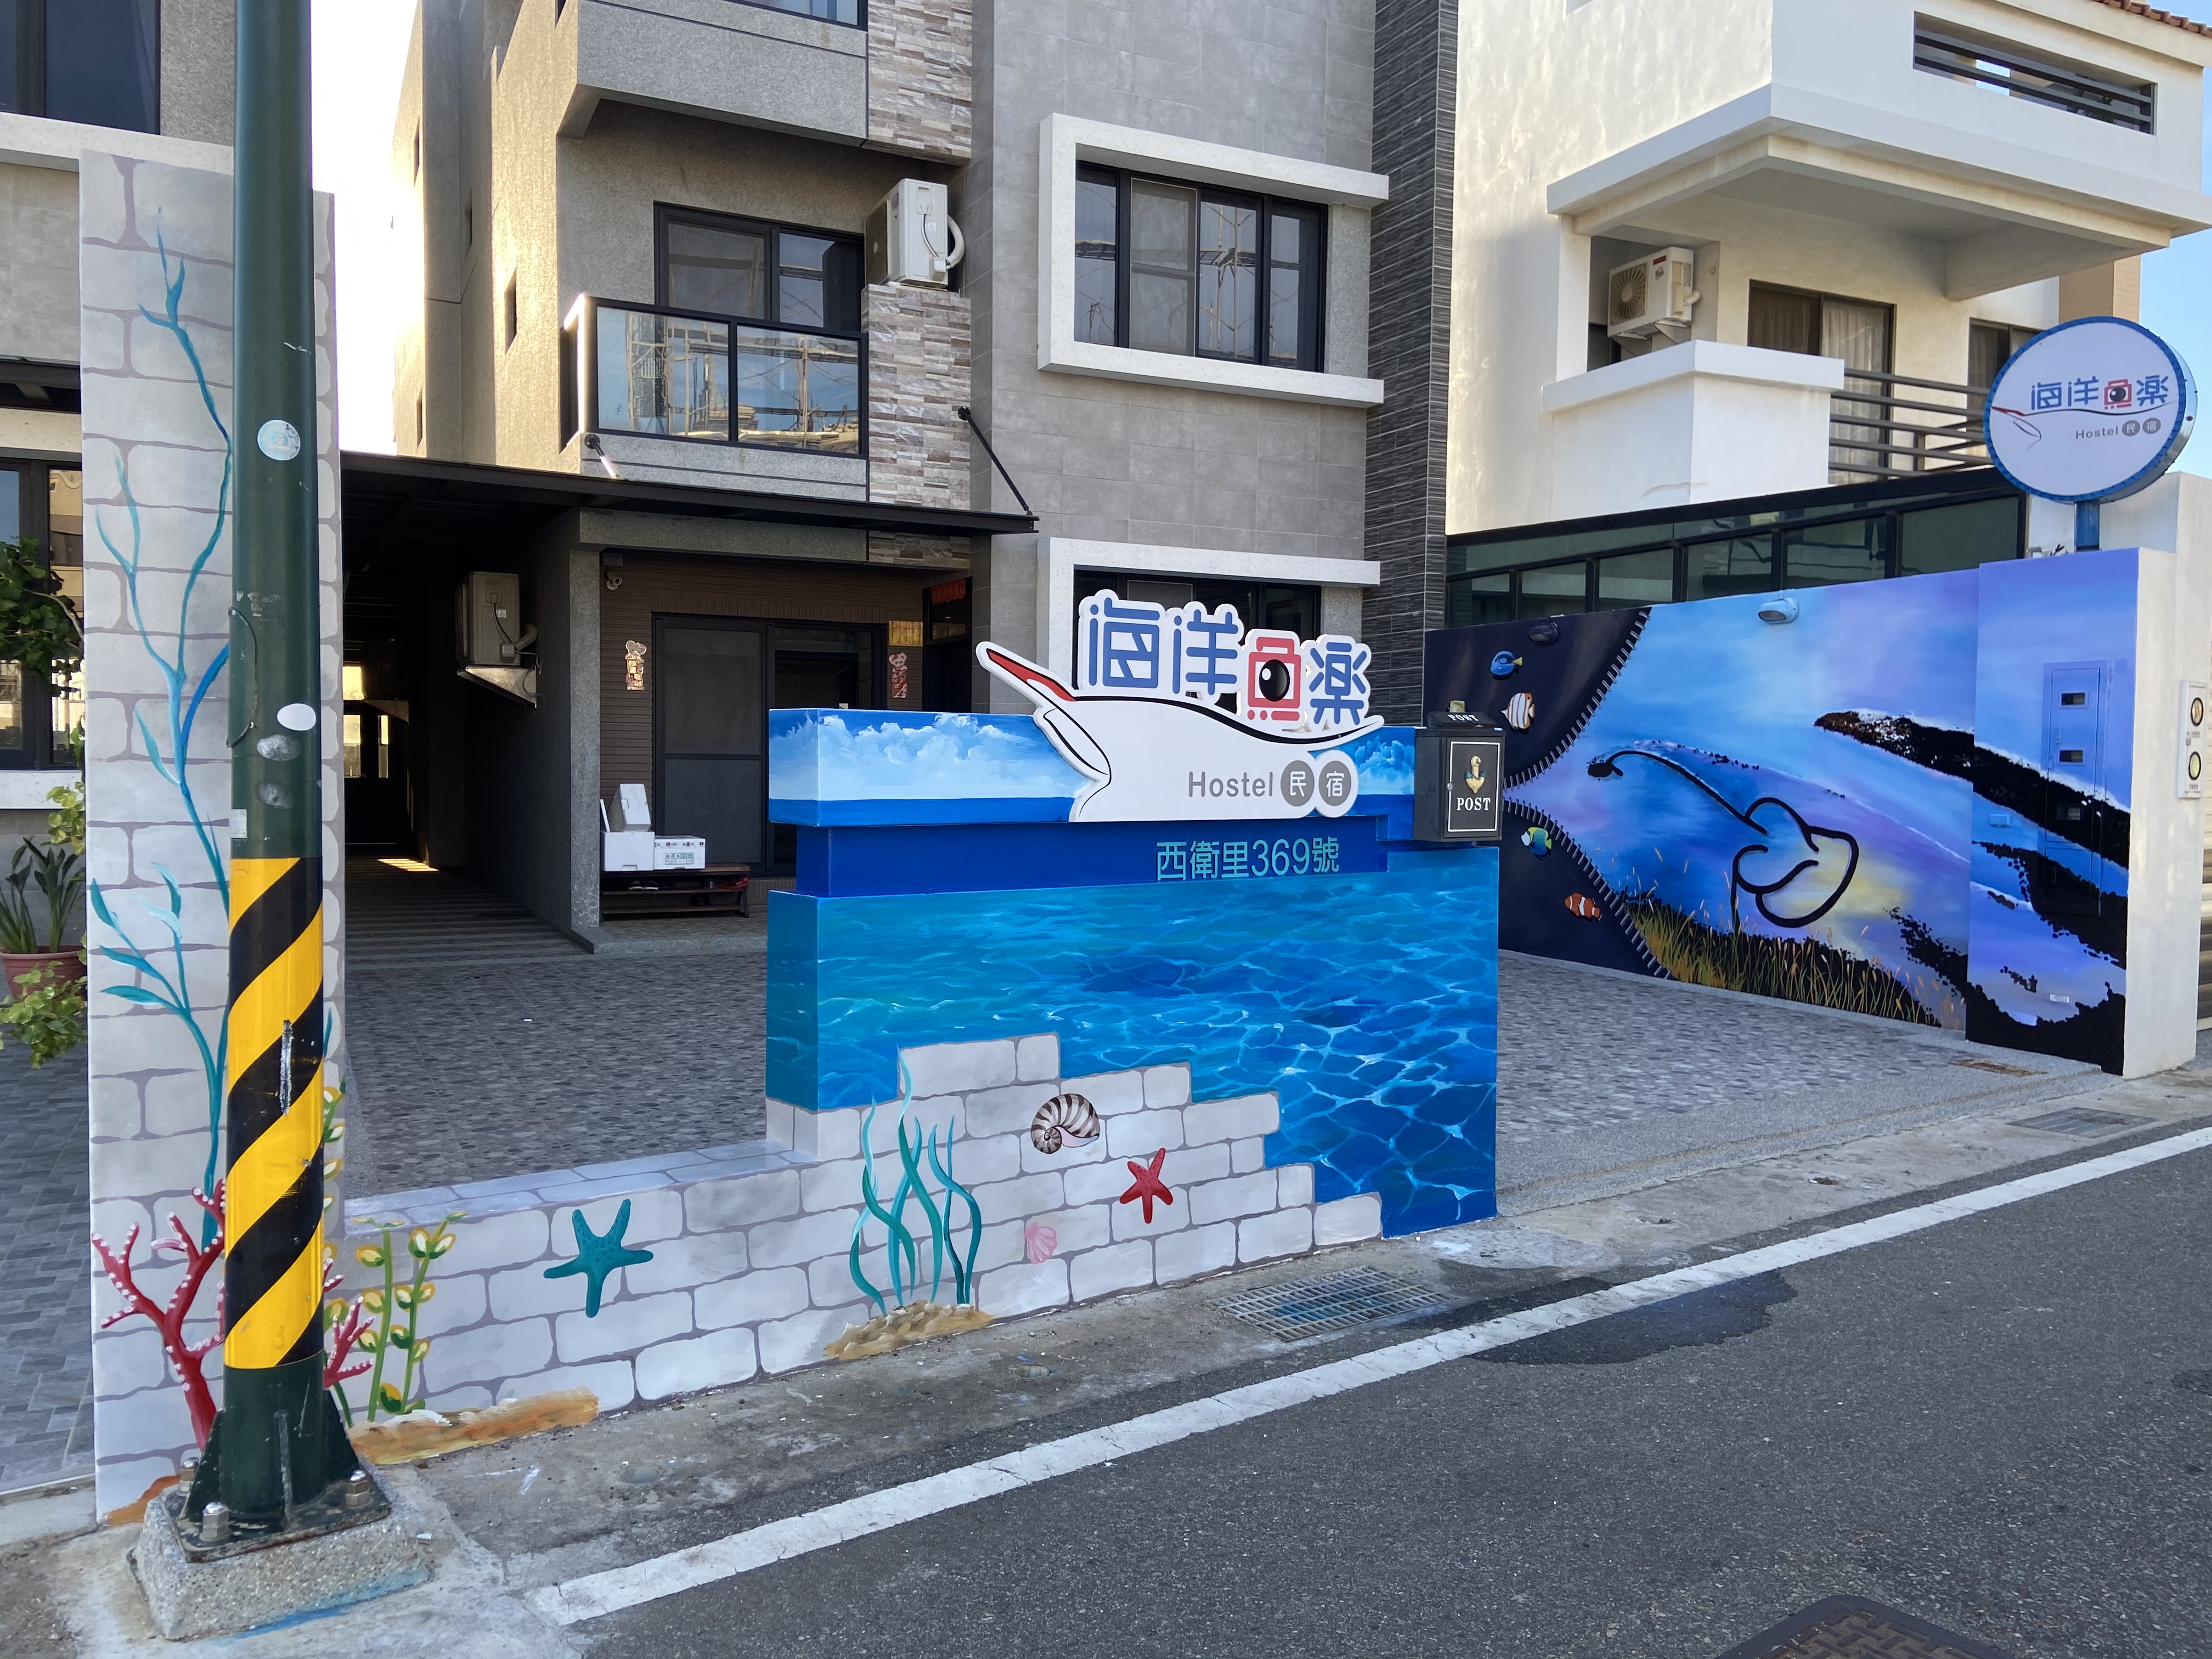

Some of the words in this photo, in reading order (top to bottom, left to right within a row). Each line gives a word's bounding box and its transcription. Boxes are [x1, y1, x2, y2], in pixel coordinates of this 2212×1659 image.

[2075, 426, 2118, 439] Hostel
[1188, 771, 1273, 797] Hostel
[1456, 797, 1491, 811] POST
[1156, 836, 1340, 881] 西衛里369號
